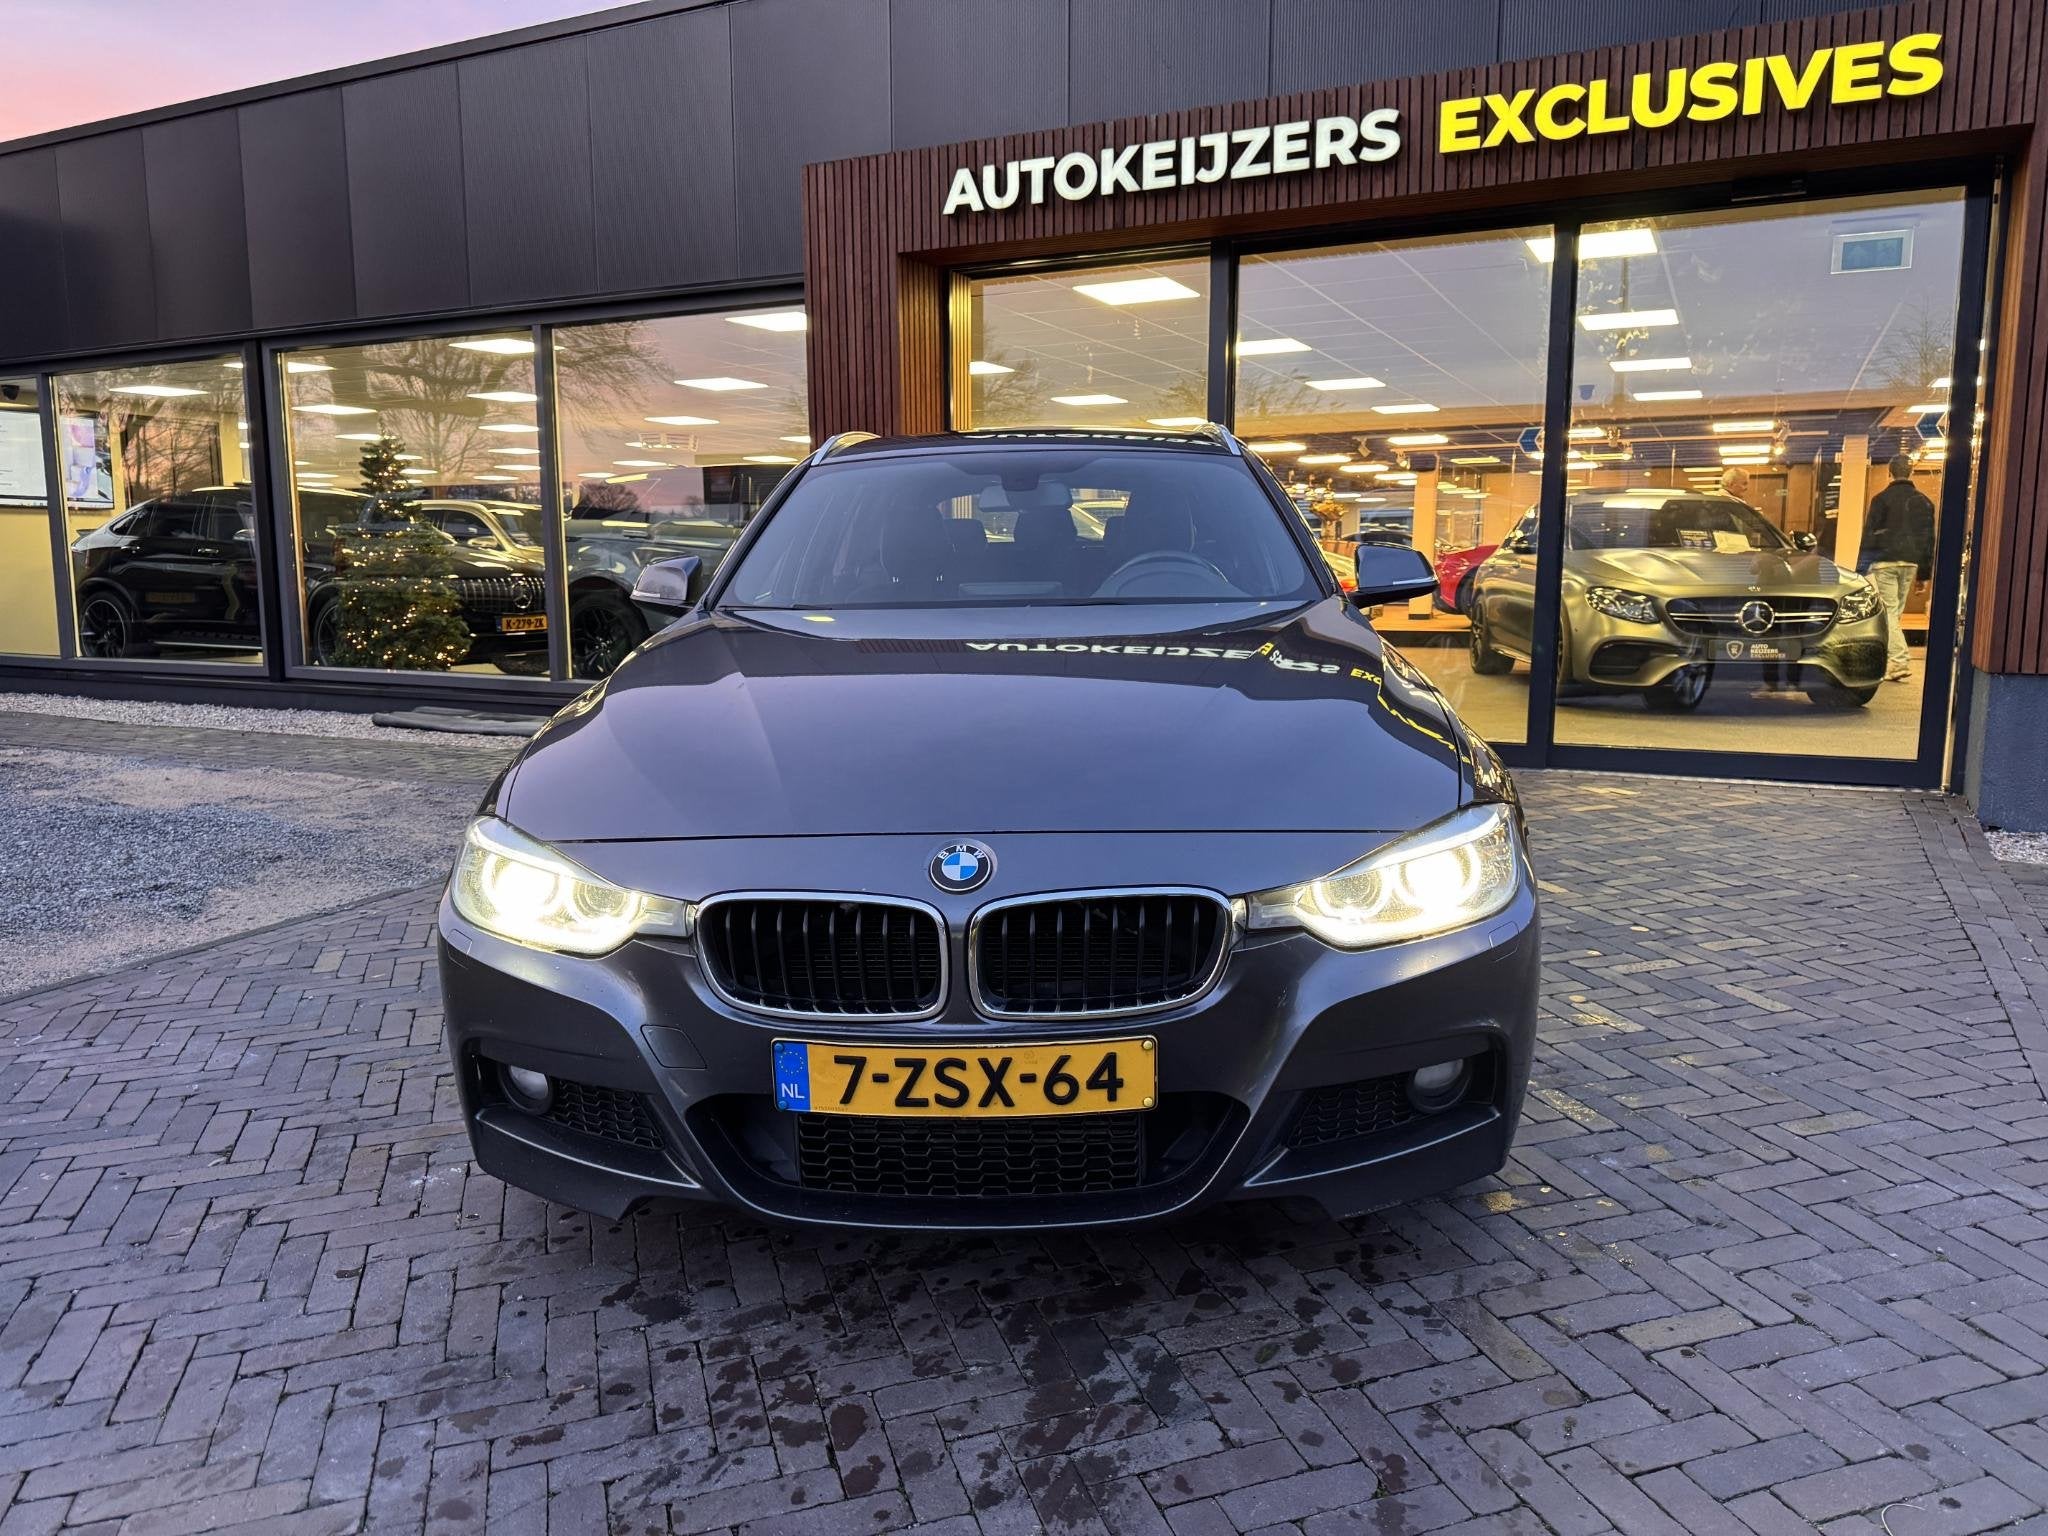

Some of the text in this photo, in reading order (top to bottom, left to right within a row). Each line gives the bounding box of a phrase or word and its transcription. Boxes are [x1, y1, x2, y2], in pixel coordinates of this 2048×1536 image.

[942, 33, 1944, 216] AUTOKEIJZERS EXCLUSIVES
[938, 845, 985, 860] BMW
[781, 1083, 805, 1099] NL
[834, 1052, 1124, 1108] 7-ZSX-64
